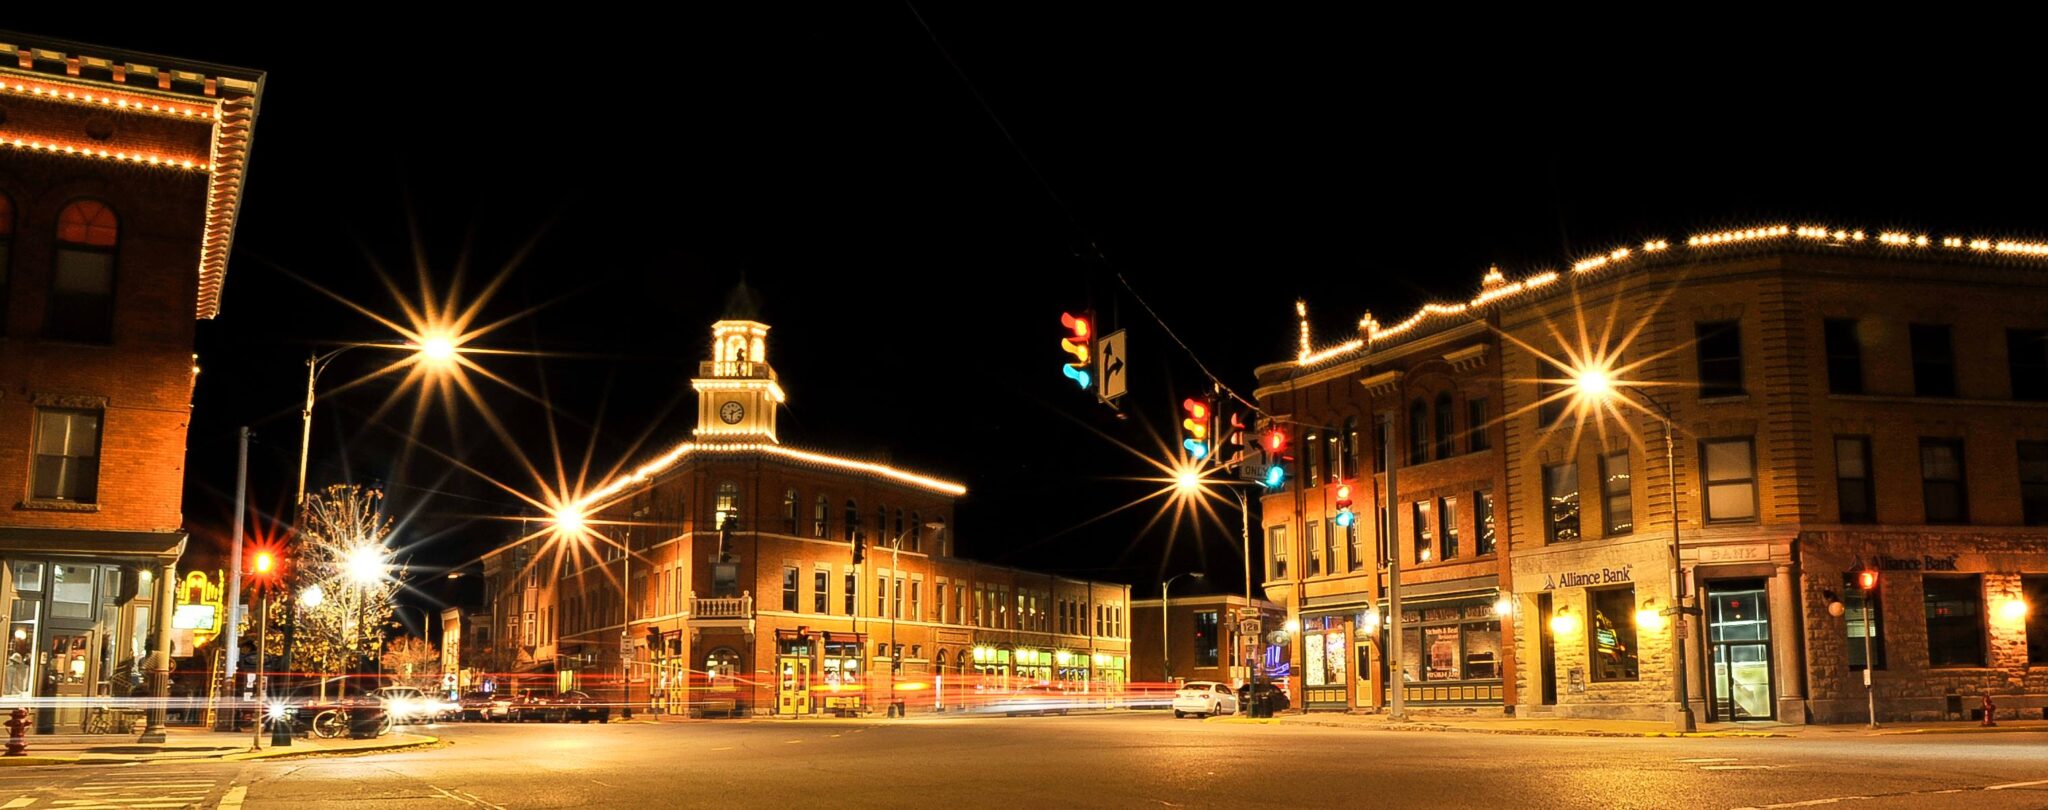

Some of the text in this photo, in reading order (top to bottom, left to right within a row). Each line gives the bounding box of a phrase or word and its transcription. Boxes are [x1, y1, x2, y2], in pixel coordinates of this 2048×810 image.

[1245, 465, 1269, 475] ONLY
[1711, 548, 1757, 560] BANK
[1871, 554, 1957, 571] Alliance Bank
[1559, 572, 1601, 588] Alliance
[1603, 567, 1631, 584] Bank
